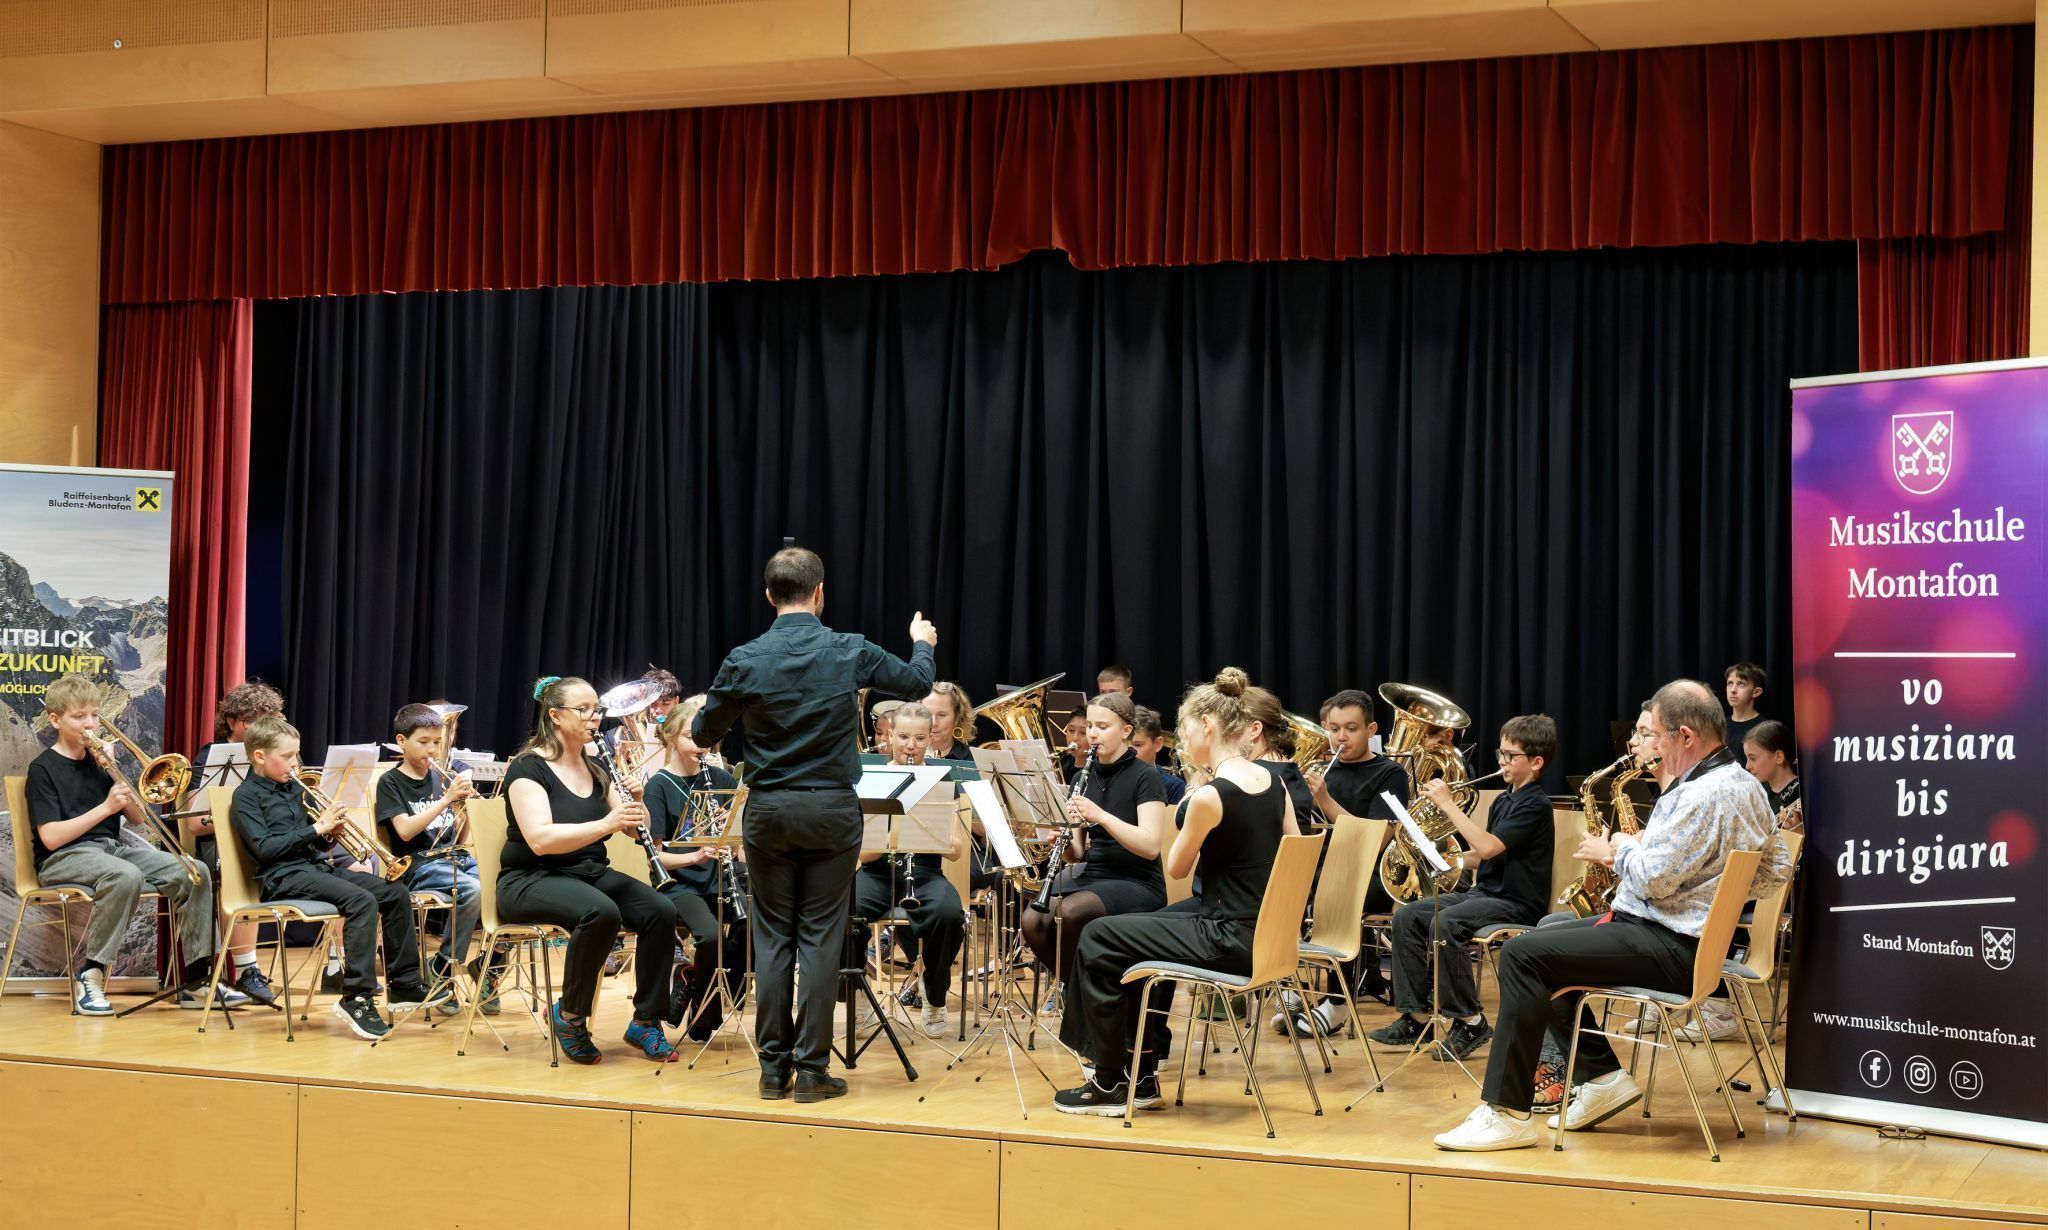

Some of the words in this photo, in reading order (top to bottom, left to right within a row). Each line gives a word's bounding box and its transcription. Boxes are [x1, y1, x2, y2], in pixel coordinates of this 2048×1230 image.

[48, 499, 132, 511] Bludenz-Montafon
[64, 491, 132, 502] Raiffeisenbank
[1829, 506, 2025, 547] Musikschule
[1847, 562, 1999, 599] Montafon
[0, 628, 95, 649] ITBLICK
[0, 653, 108, 674] ZUKUNFT.
[1901, 678, 1943, 706] vo
[1833, 723, 2017, 763] musiziara
[1896, 778, 1949, 817] bis
[1836, 833, 2009, 885] dirigiara
[1862, 933, 1903, 951] Stand
[1906, 936, 1975, 958] Montafon
[1813, 1011, 2037, 1048] www.musikschule-montafon.at
